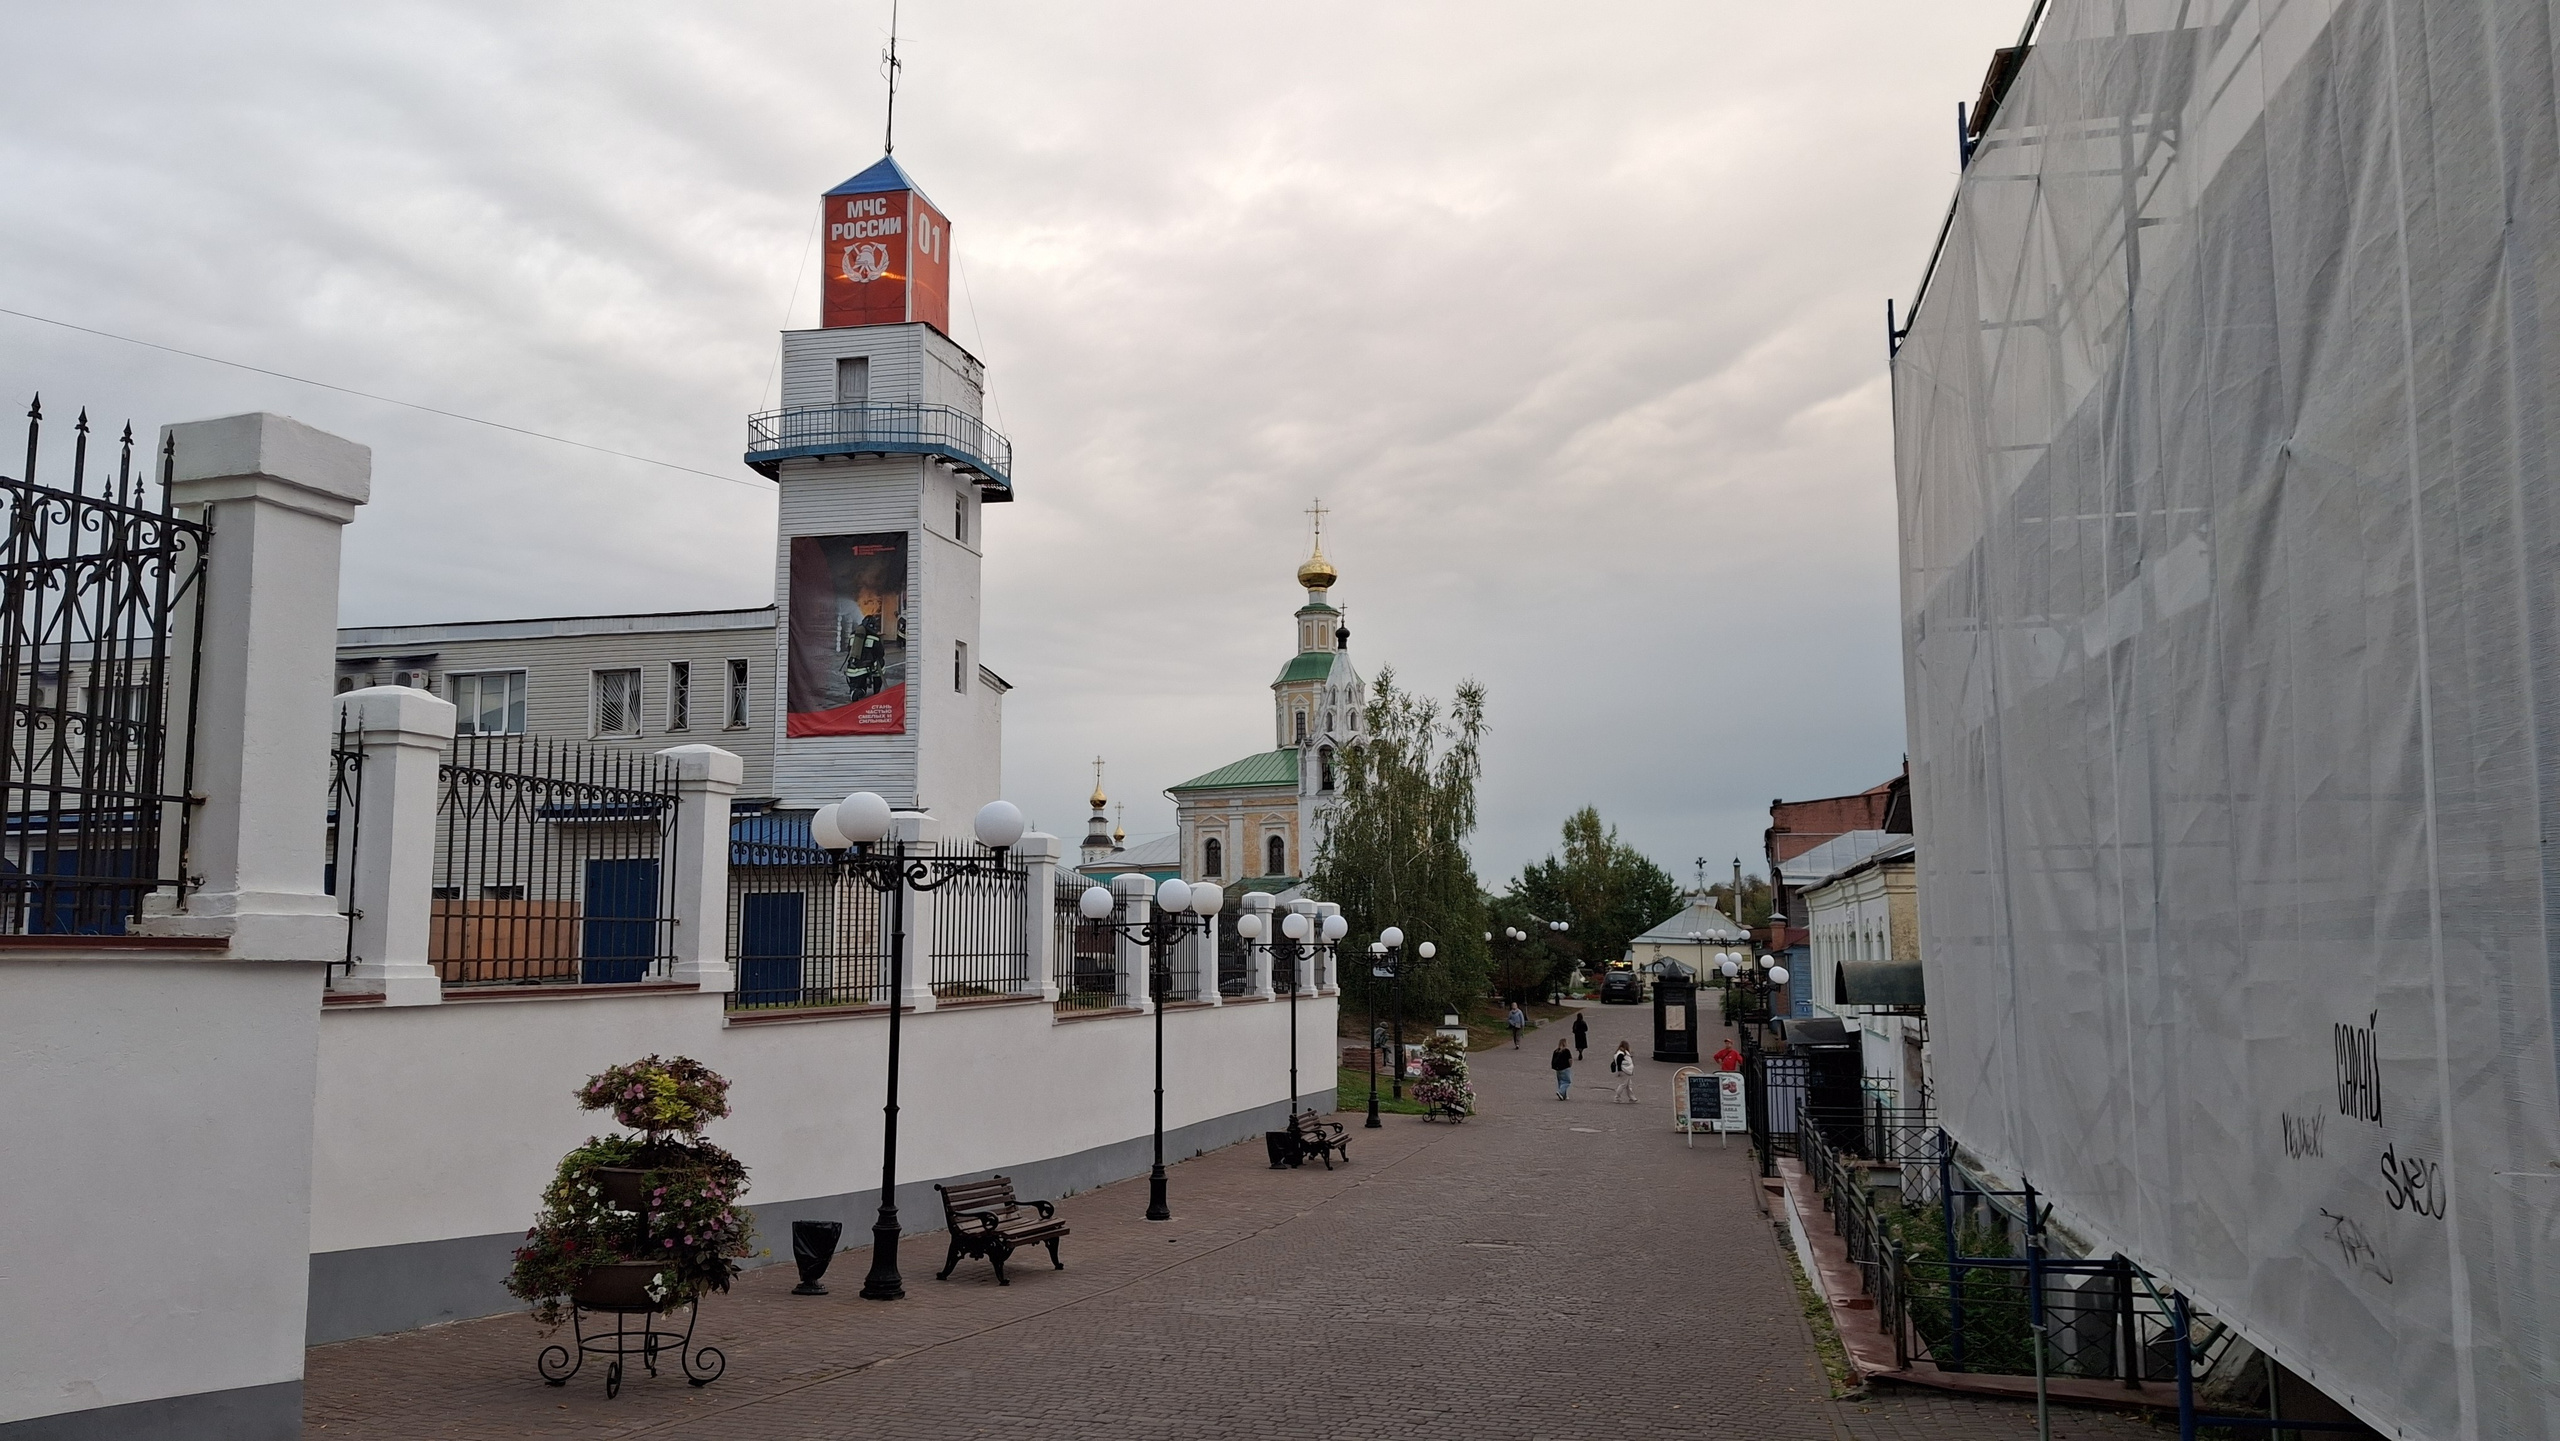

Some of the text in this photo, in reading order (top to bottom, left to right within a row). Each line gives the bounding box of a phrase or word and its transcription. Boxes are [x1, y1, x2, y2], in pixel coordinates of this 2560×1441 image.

[847, 197, 887, 219] МЧС
[831, 217, 902, 241] РОССИИ
[918, 212, 941, 265] 01
